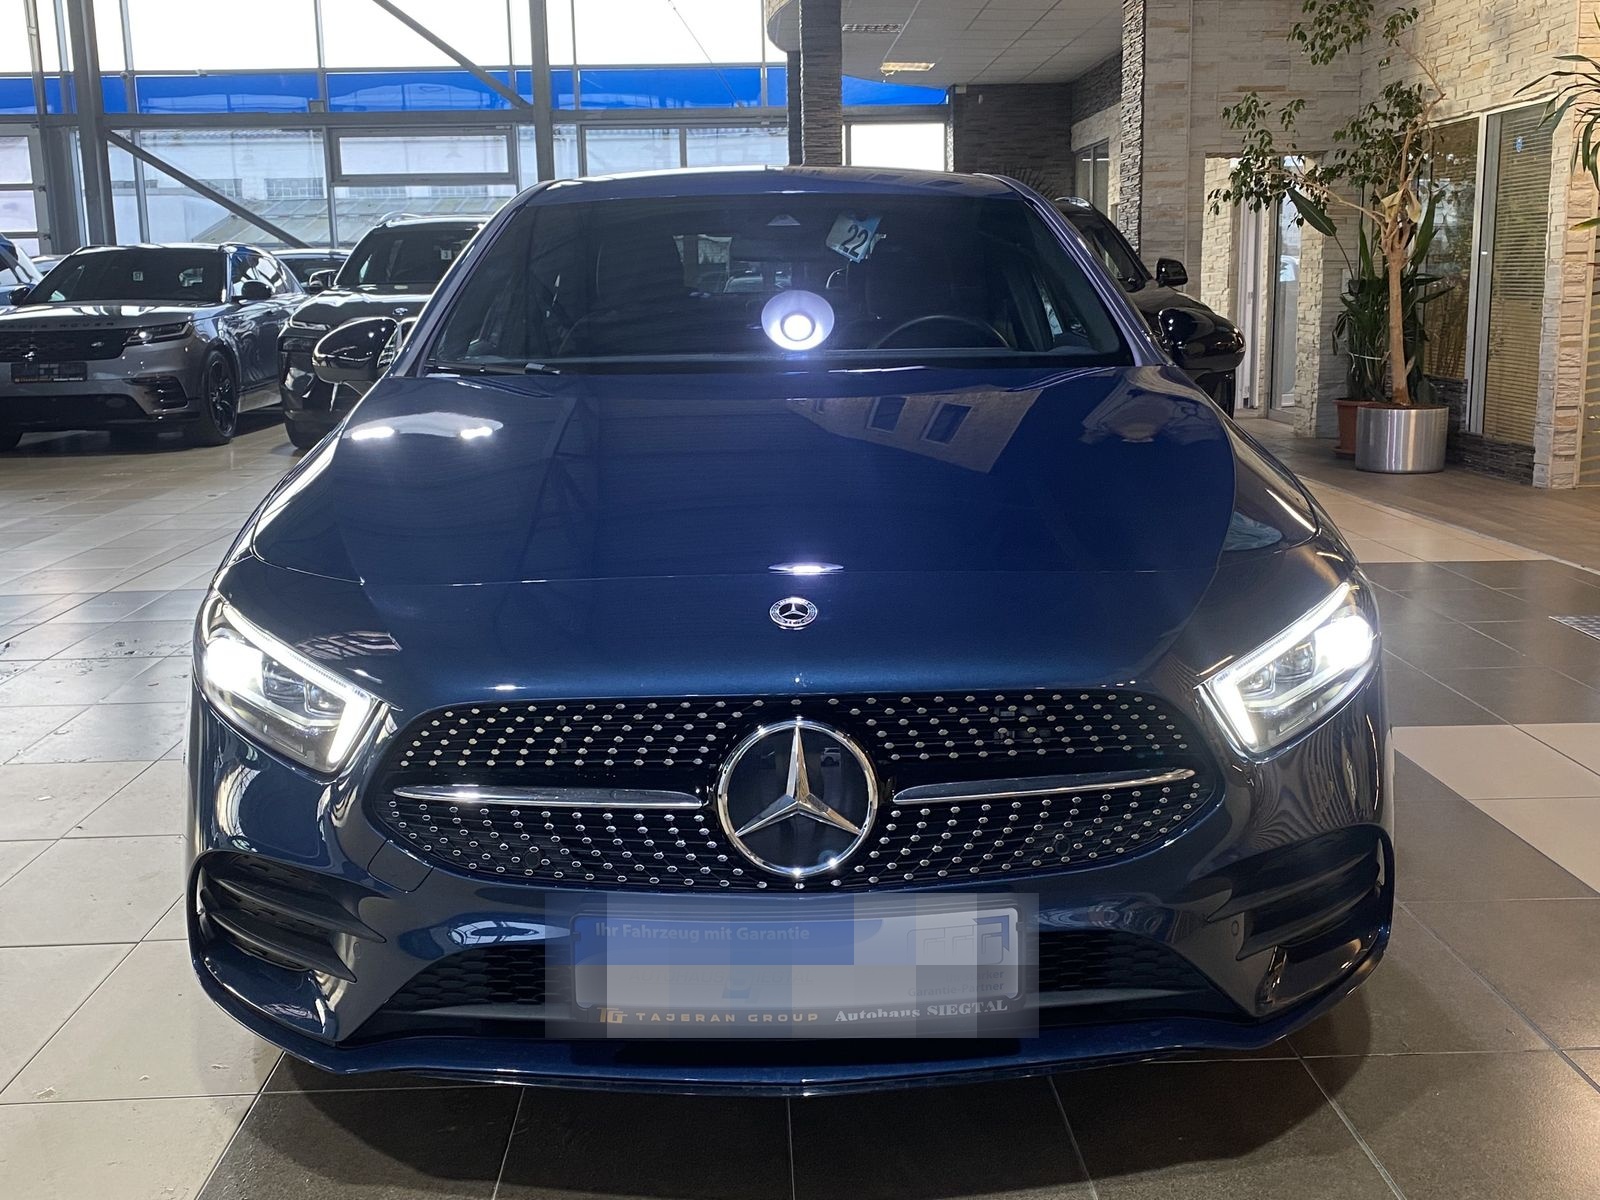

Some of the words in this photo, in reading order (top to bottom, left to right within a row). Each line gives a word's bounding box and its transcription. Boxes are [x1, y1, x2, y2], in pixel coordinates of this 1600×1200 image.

[839, 224, 869, 259] 22
[595, 922, 618, 936] Ihr
[623, 924, 699, 943] Fahrzeug
[704, 926, 732, 941] mit
[736, 926, 810, 941] Garantie
[907, 982, 1004, 997] Garantie-Partner
[636, 1012, 735, 1022] TAJERAN
[747, 1013, 818, 1022] GROUP
[834, 1008, 921, 1022] Autohaus
[926, 1000, 1008, 1016] SIEGTAL
